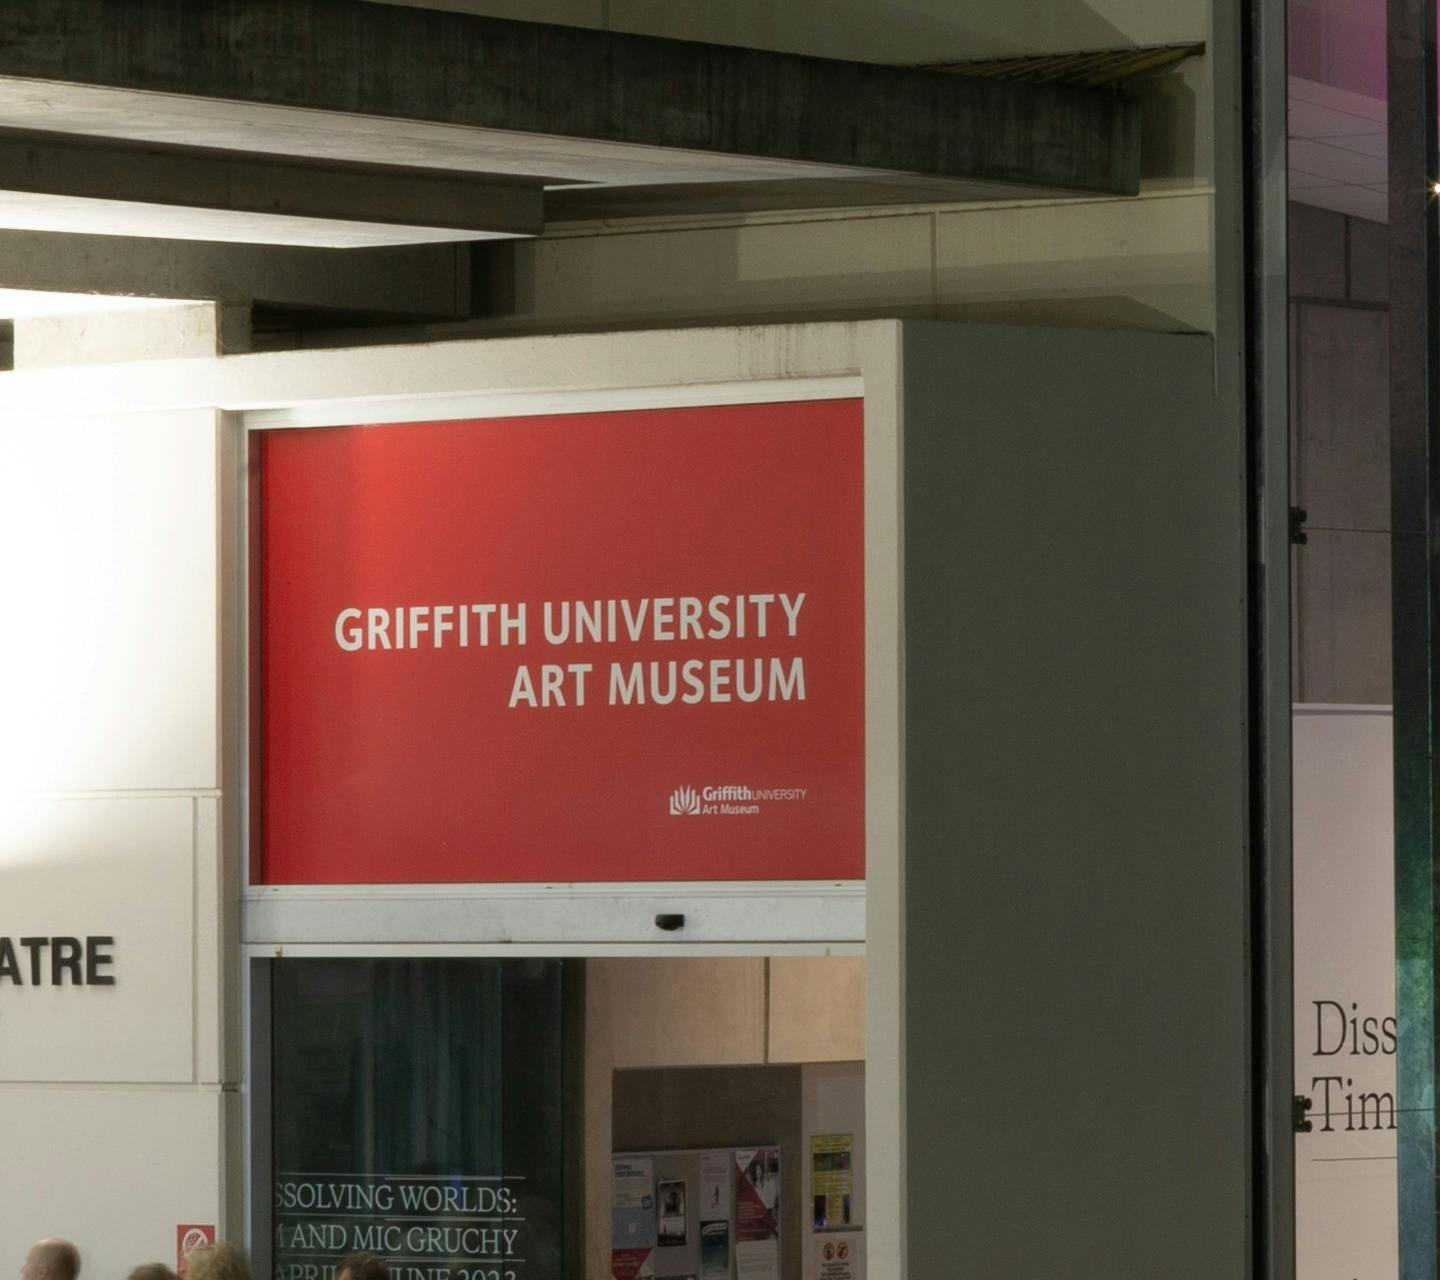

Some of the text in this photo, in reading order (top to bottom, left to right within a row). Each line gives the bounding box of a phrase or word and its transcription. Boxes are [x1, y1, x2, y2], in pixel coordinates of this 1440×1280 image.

[334, 592, 807, 652] GRIFFITH UNIVERSITY
[507, 656, 807, 709] ART MUSEUM
[702, 785, 751, 801] Griffith
[702, 803, 760, 815] Art Museum
[1312, 1075, 1398, 1132] Tim
[398, 1185, 518, 1214] WORLDS:
[290, 1223, 348, 1250] AND
[351, 1225, 402, 1252] MIC
[406, 1226, 519, 1255] GRUCHY
